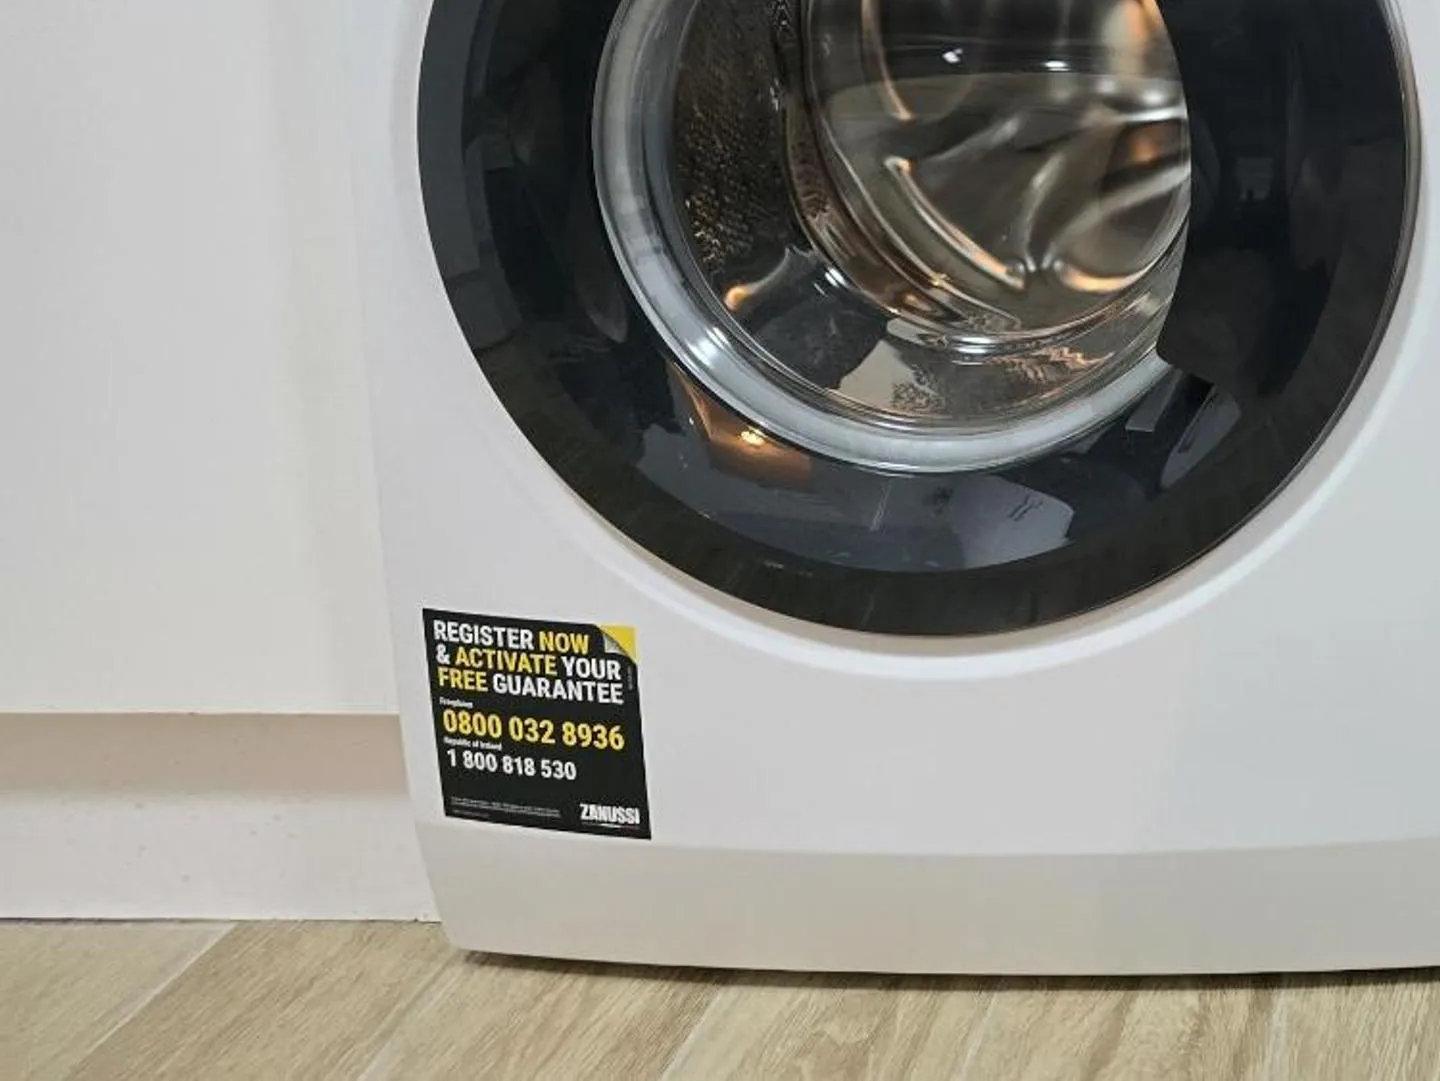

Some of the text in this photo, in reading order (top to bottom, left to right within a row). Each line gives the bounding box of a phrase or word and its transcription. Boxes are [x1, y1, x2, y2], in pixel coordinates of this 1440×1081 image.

[433, 620, 589, 654] REGISTER NOW
[436, 643, 450, 665] &
[455, 647, 557, 676] ACTIVATE
[561, 656, 621, 680] YOUR
[438, 667, 488, 692] FREE
[492, 674, 624, 705] GUARANTEE
[443, 709, 625, 751] 0800 032 8936
[447, 749, 577, 780] 1 800 818 530
[579, 803, 641, 824] ZANUSSI
